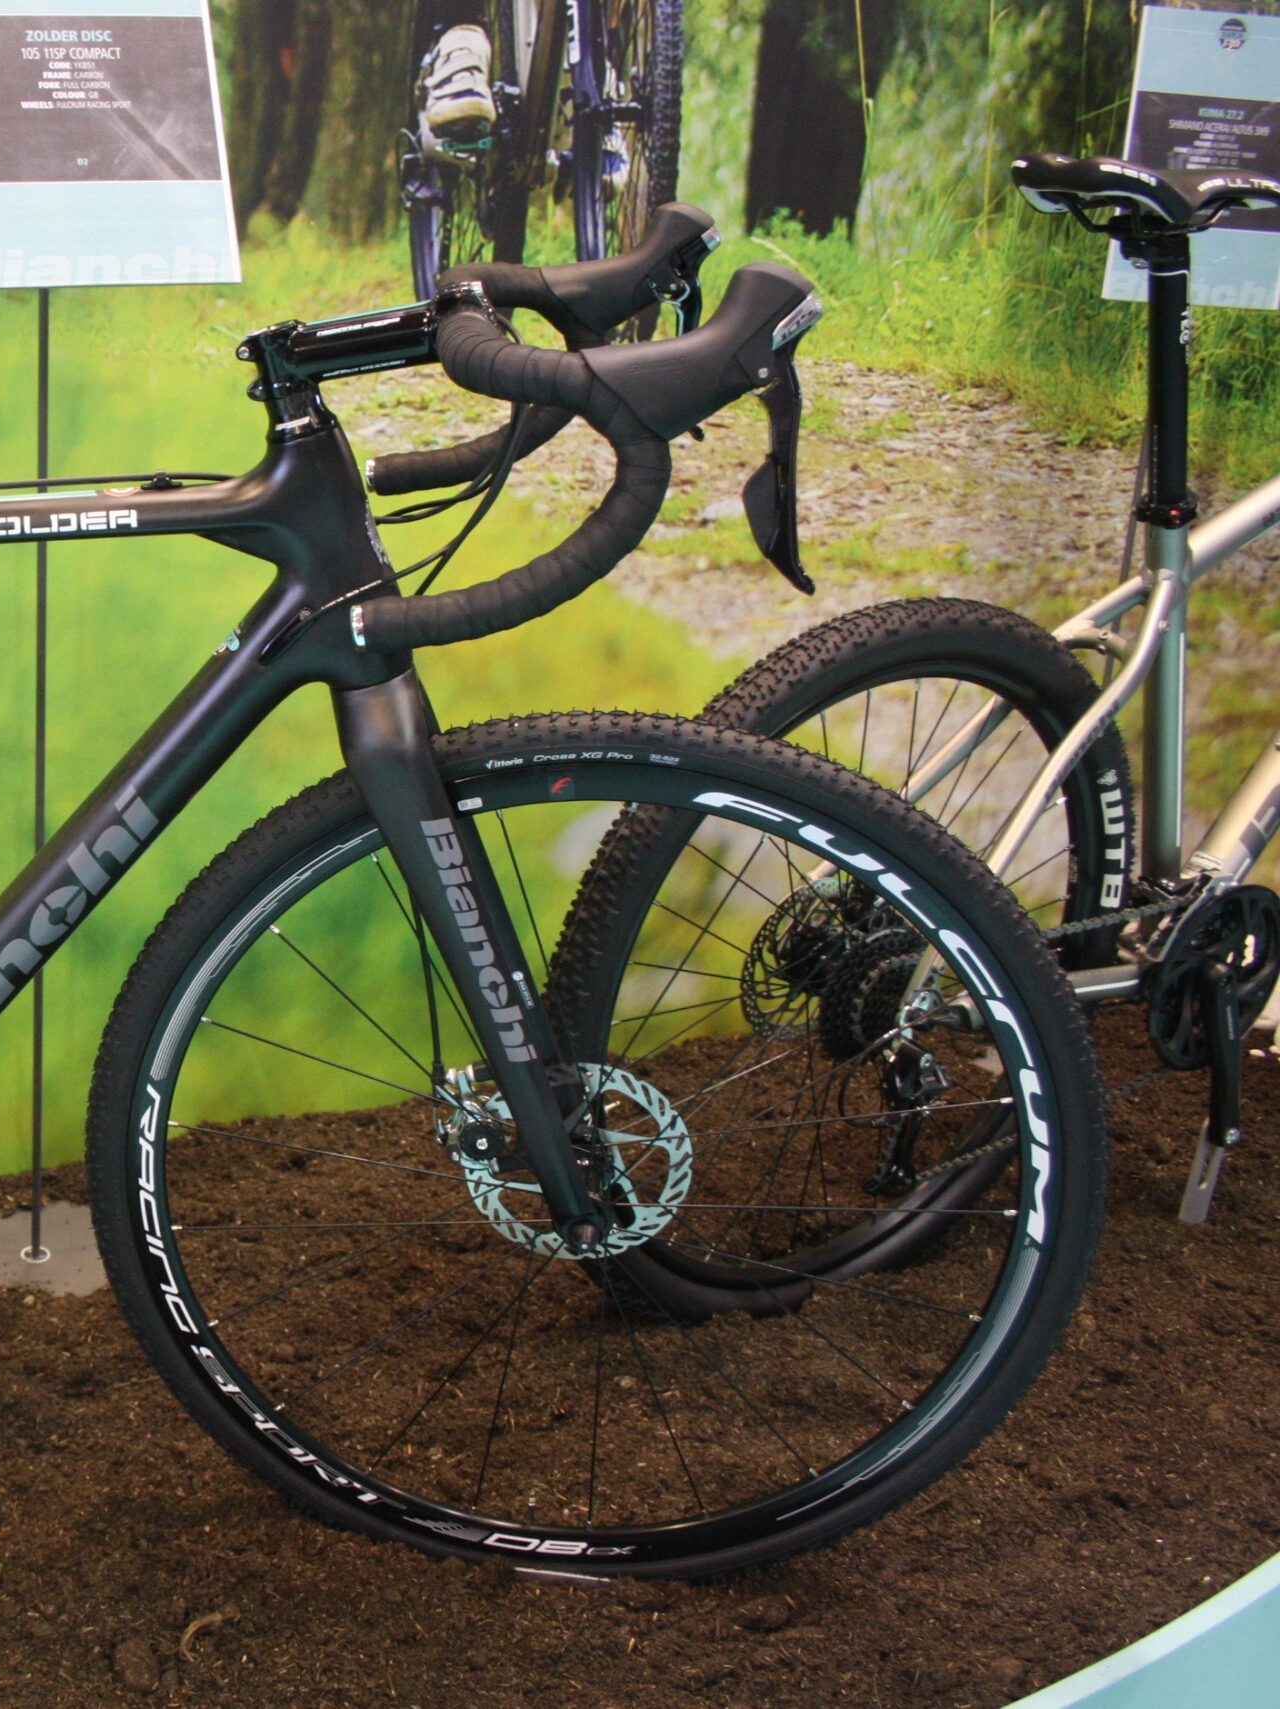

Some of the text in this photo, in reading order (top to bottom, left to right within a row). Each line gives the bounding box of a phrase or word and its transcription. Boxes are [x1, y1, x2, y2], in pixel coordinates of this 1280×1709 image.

[25, 29, 113, 42] ZOLDER DISC
[20, 47, 121, 59] 105 11SP COMPACT
[81, 81, 111, 89] CARBON
[87, 101, 111, 109] RACING
[485, 751, 634, 770] Vittoria Cross XG Pro
[1099, 788, 1126, 908] WTB
[419, 818, 539, 1063] Bianchi
[693, 790, 1053, 1245] FULCRUM
[135, 1083, 198, 1335] RACING
[483, 1532, 587, 1556] DB
